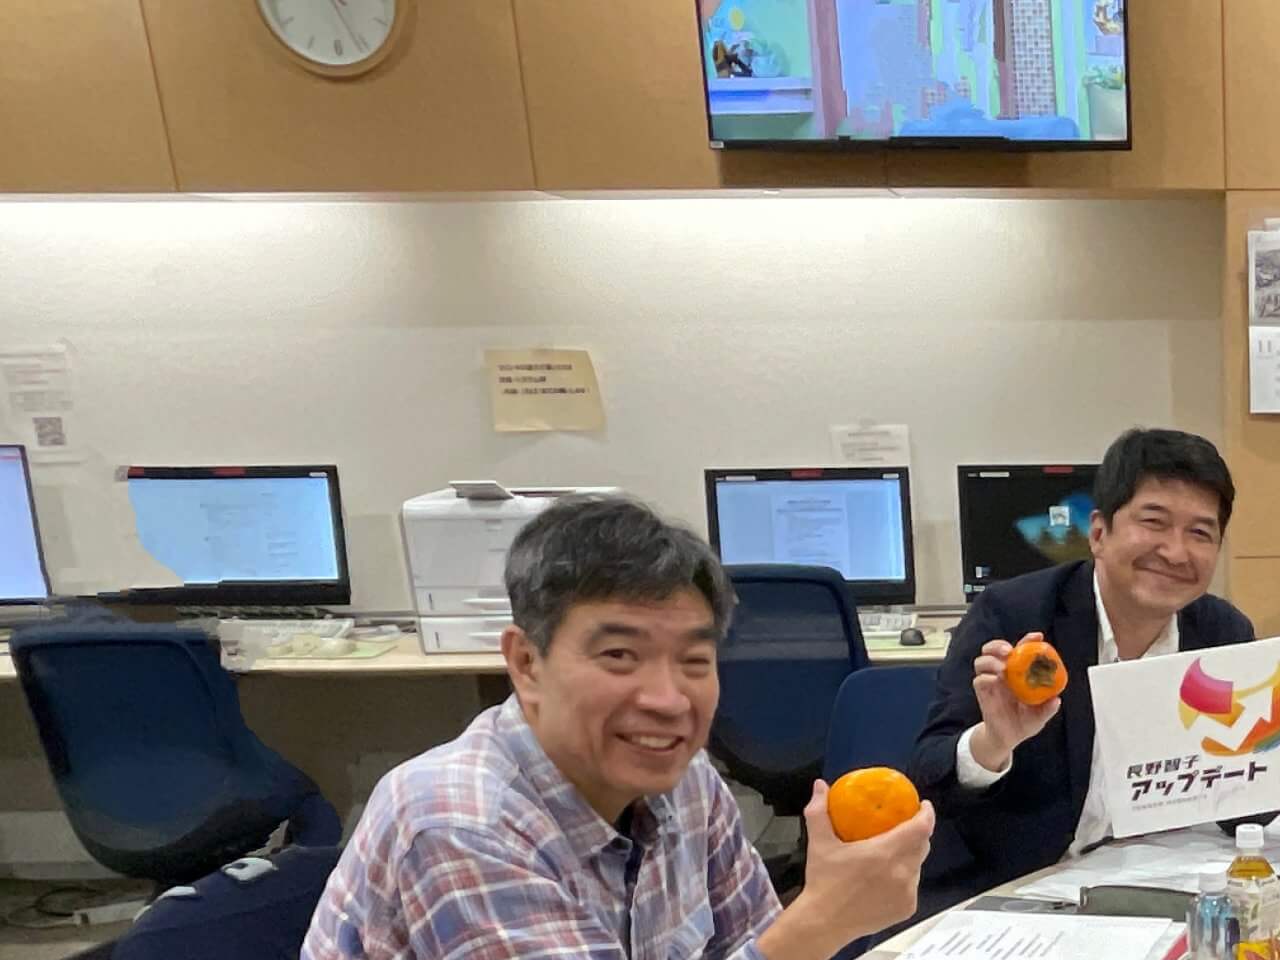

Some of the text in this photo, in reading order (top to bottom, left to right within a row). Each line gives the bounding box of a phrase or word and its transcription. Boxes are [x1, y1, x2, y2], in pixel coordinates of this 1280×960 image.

[1127, 753, 1200, 780] 長野智子
[1131, 761, 1268, 801] アップデート
